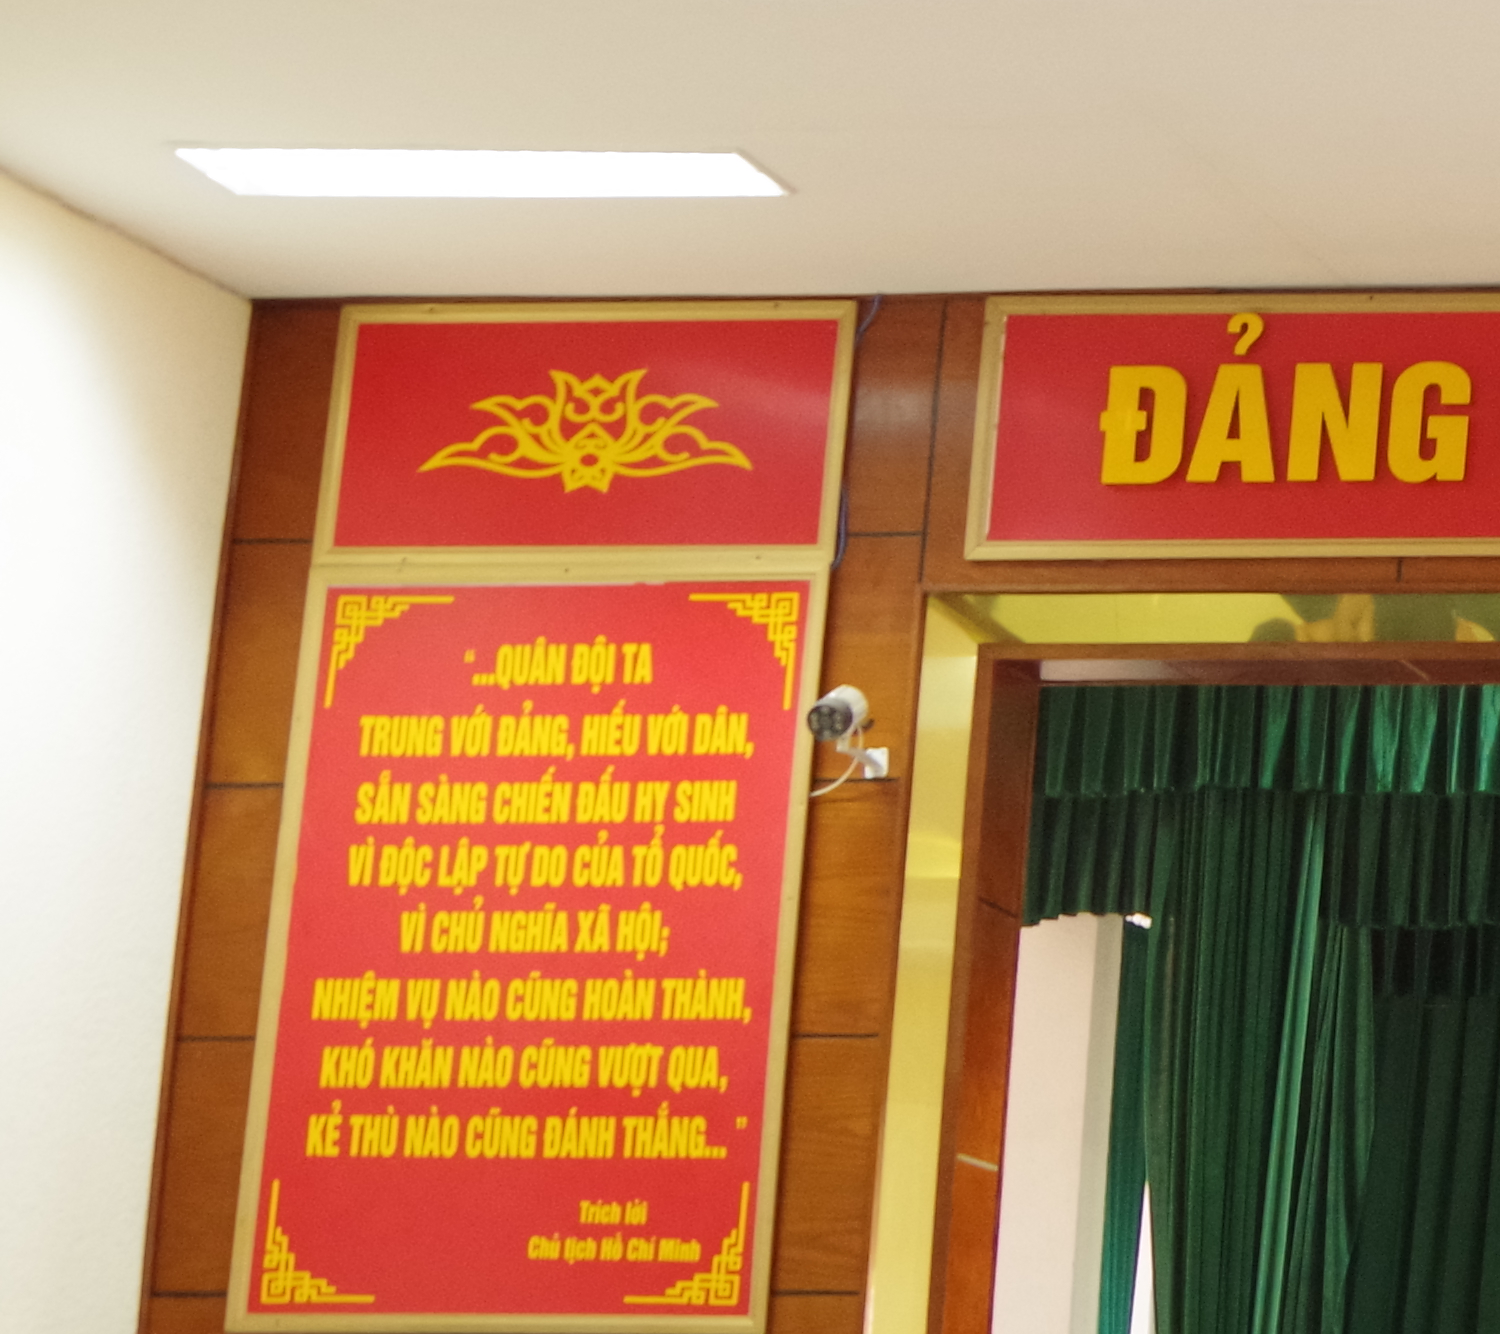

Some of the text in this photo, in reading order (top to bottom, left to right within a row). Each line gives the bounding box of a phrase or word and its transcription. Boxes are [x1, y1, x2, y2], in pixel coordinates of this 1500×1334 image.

[1100, 312, 1472, 485] ĐẢNG
[570, 635, 616, 693] ĐỘI
[622, 643, 652, 684] TA
[359, 699, 754, 760] TRUNG VỚI ĐẢNG, HIẾU VỚI DÂN,
[415, 774, 489, 824] SÀNG
[492, 766, 573, 824] CHIẾN
[575, 765, 631, 823] ĐẤU
[634, 781, 671, 823] HY
[673, 780, 737, 823] SINH
[348, 824, 743, 896] VÌ ĐỘC LẬP TỰ DO CỦA TỔ QUỐC,
[400, 903, 426, 953] VÌ
[430, 895, 485, 953] CHỦ
[488, 903, 569, 953] NGHĨA
[574, 904, 611, 952] XÃ
[312, 969, 751, 1029] NHIỆM VỤ NÀO CŨNG HOÀN THÀNH,
[320, 1037, 727, 1096] KHÓ KHĂN NÀO CŨNG VƯỢT QUA,
[306, 1100, 342, 1156] KẺ
[349, 1106, 399, 1157] THÙ
[404, 1106, 459, 1158] NÀO
[465, 1108, 538, 1158] CŨNG
[543, 1108, 616, 1158] ĐÁNH
